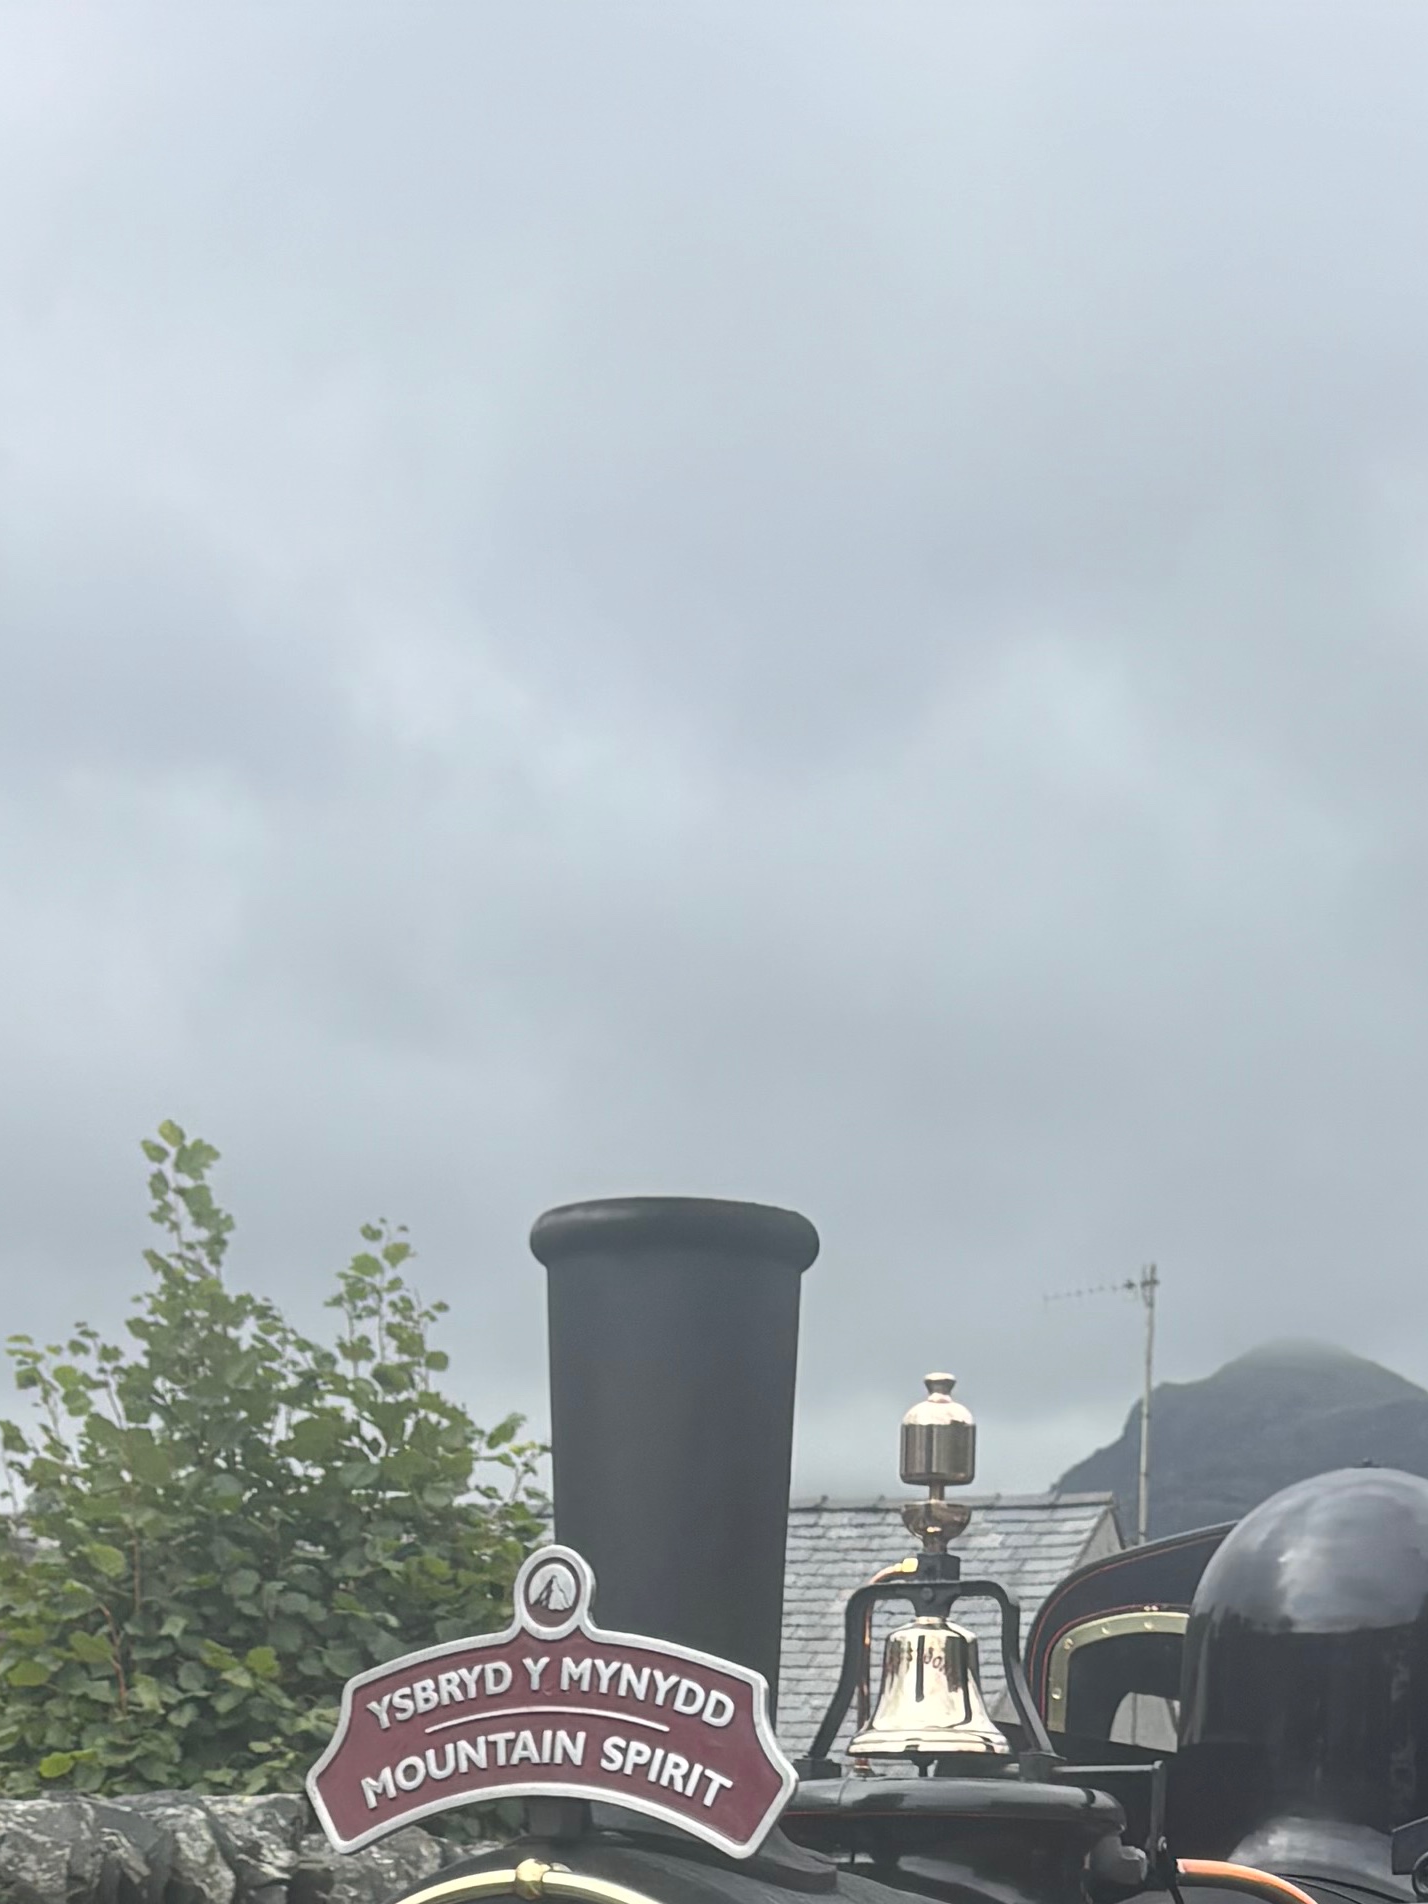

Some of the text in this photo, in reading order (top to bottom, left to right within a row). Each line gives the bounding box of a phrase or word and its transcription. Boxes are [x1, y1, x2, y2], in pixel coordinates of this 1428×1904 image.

[366, 1656, 736, 1730] YSBRYD Y MYNYDD
[360, 1730, 733, 1810] MOUNTAIN SPIRIT
